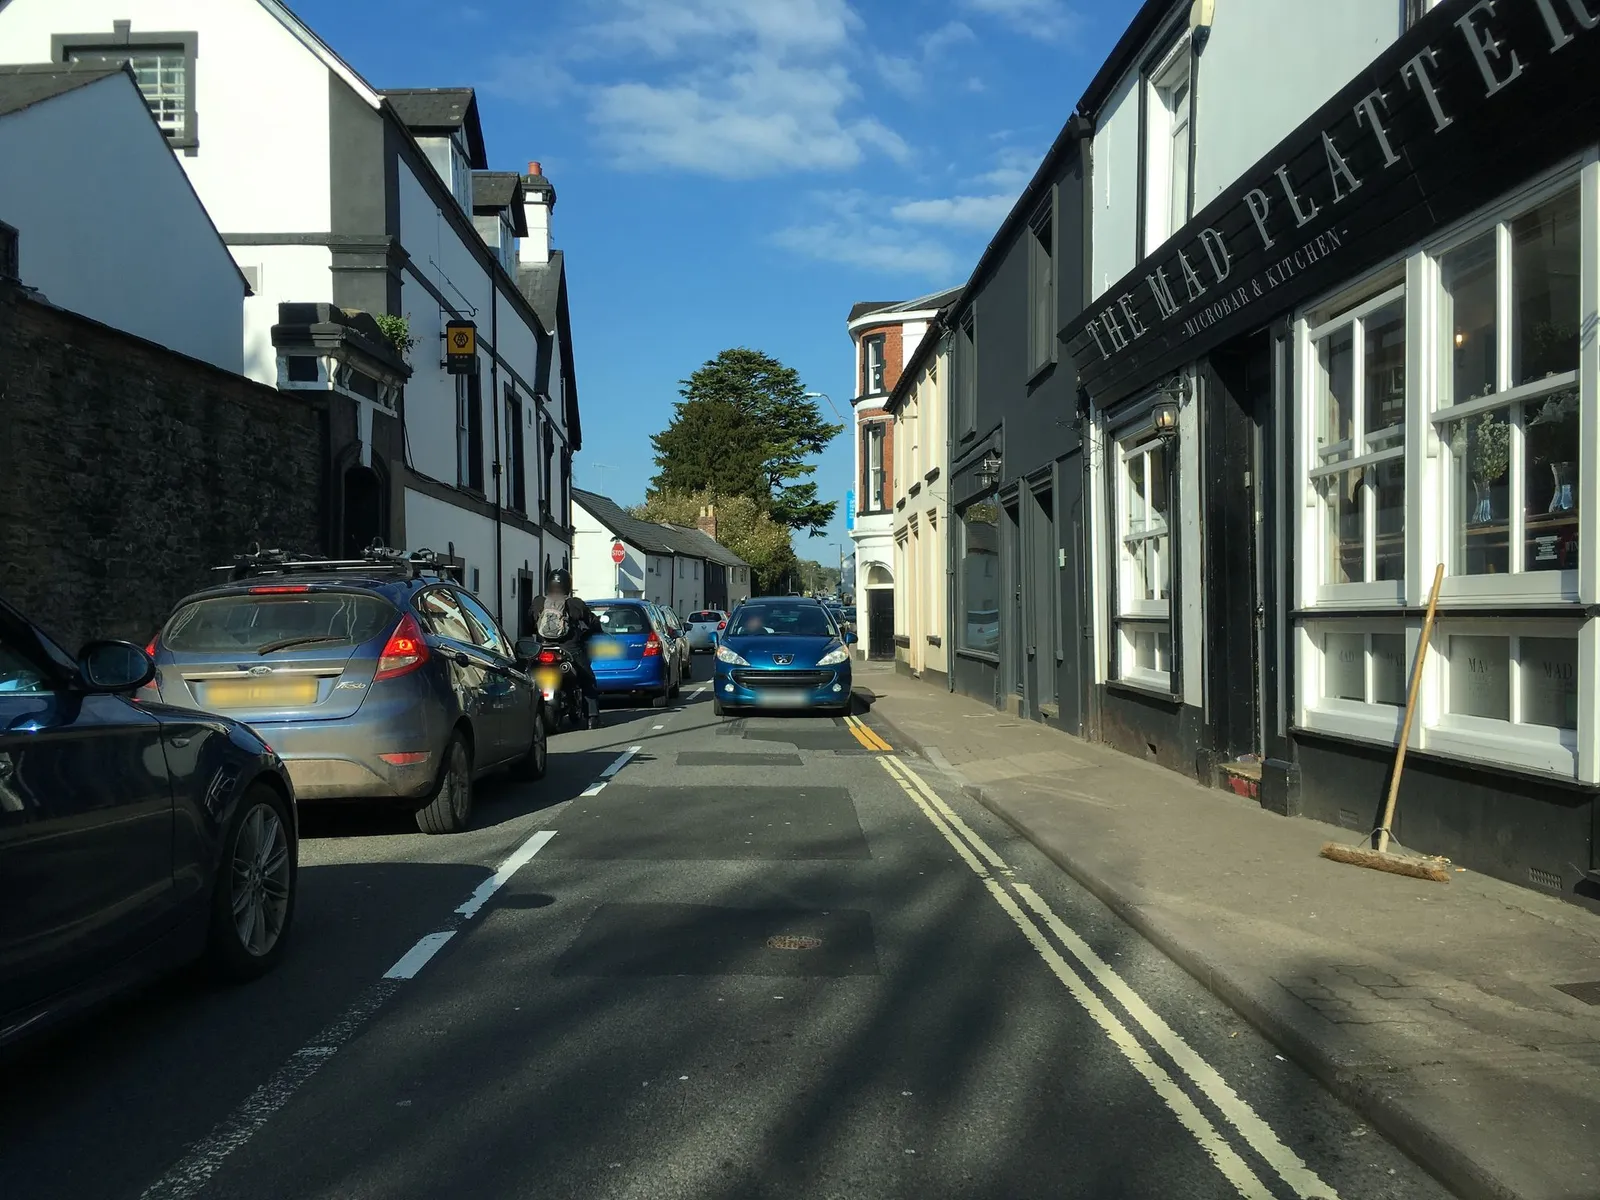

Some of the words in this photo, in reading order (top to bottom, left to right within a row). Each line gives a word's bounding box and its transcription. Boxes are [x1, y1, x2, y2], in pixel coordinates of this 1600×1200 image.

[1085, 292, 1149, 361] THE
[1145, 227, 1232, 322] MAD
[1252, 278, 1264, 299] &
[611, 549, 625, 557] STOP
